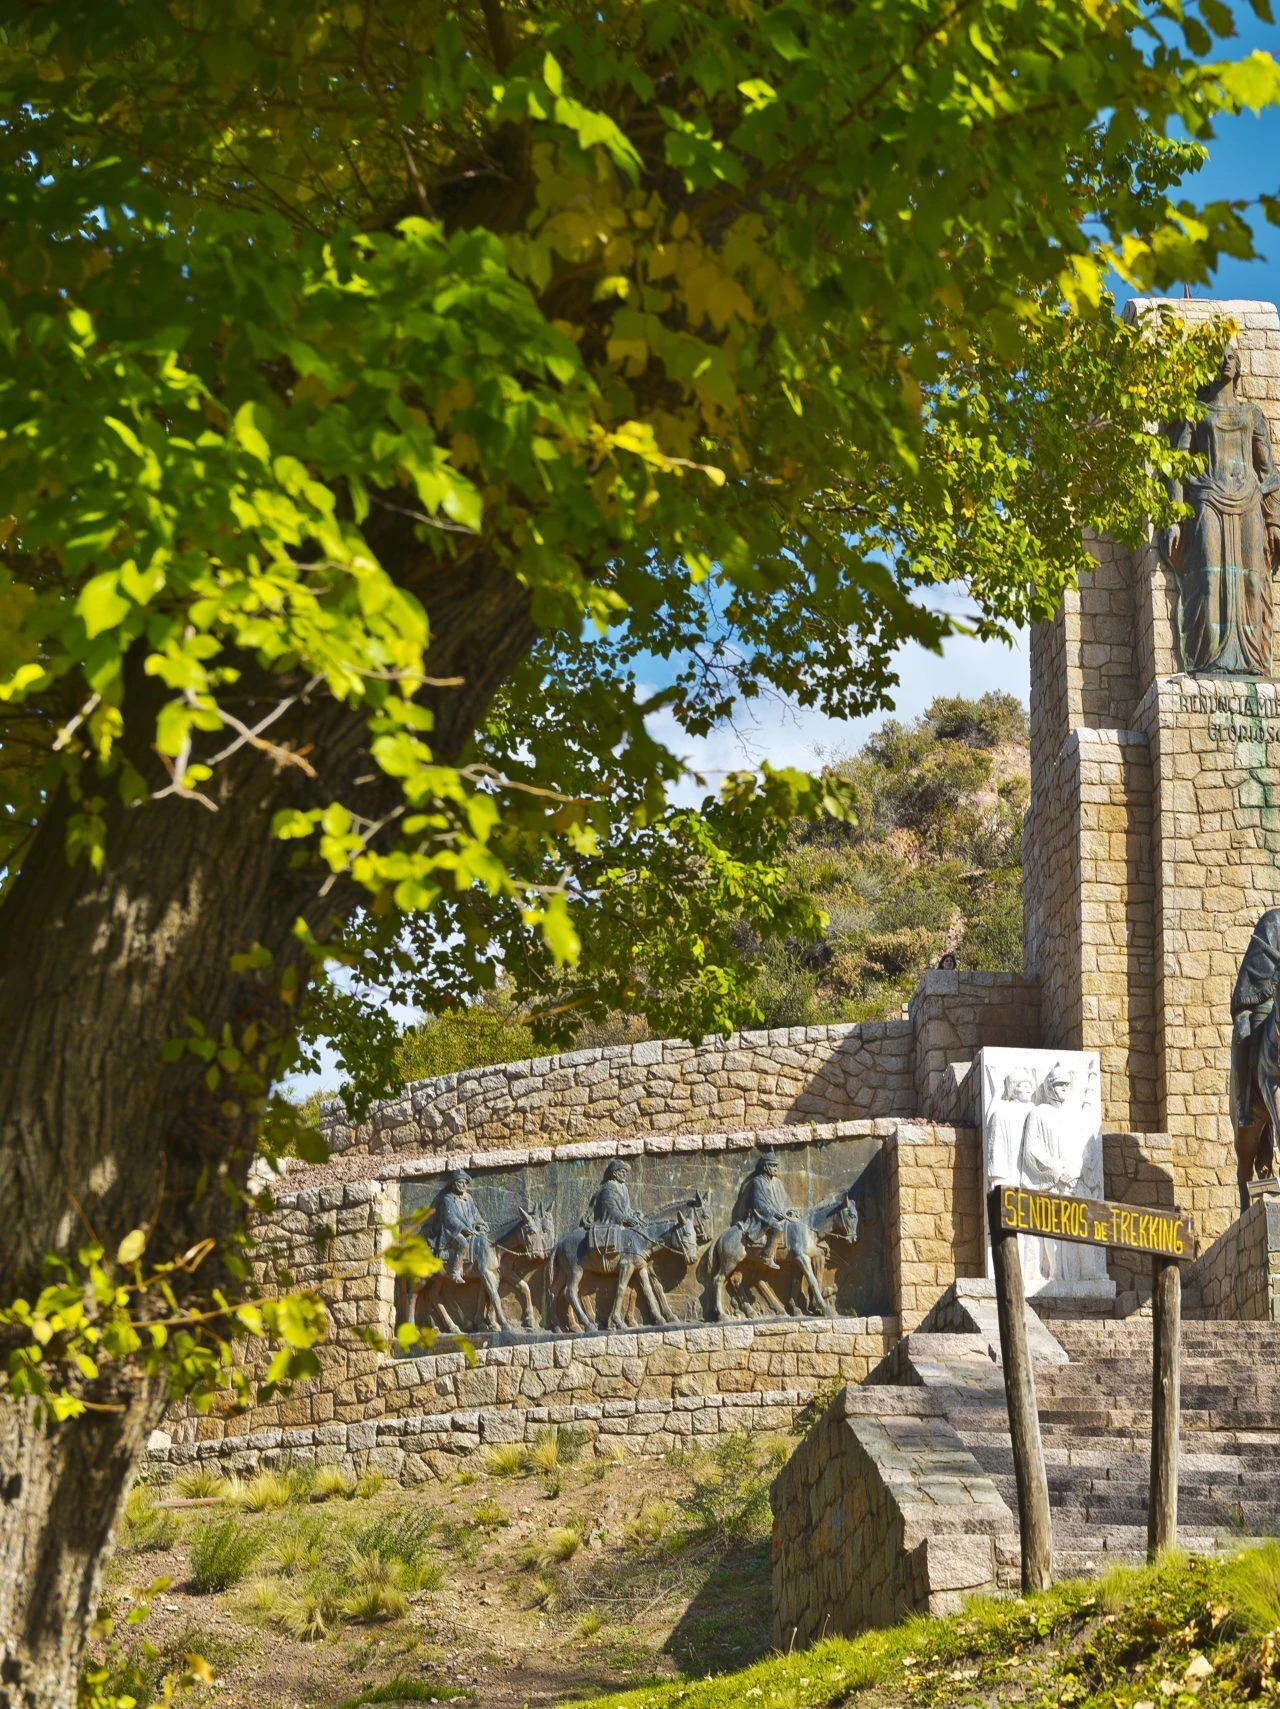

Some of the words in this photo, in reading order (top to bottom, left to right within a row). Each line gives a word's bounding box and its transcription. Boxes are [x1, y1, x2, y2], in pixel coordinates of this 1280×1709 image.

[1004, 1191, 1089, 1238] SENDEROS
[1094, 1221, 1109, 1242] DE
[1110, 1208, 1184, 1255] TREKKING
